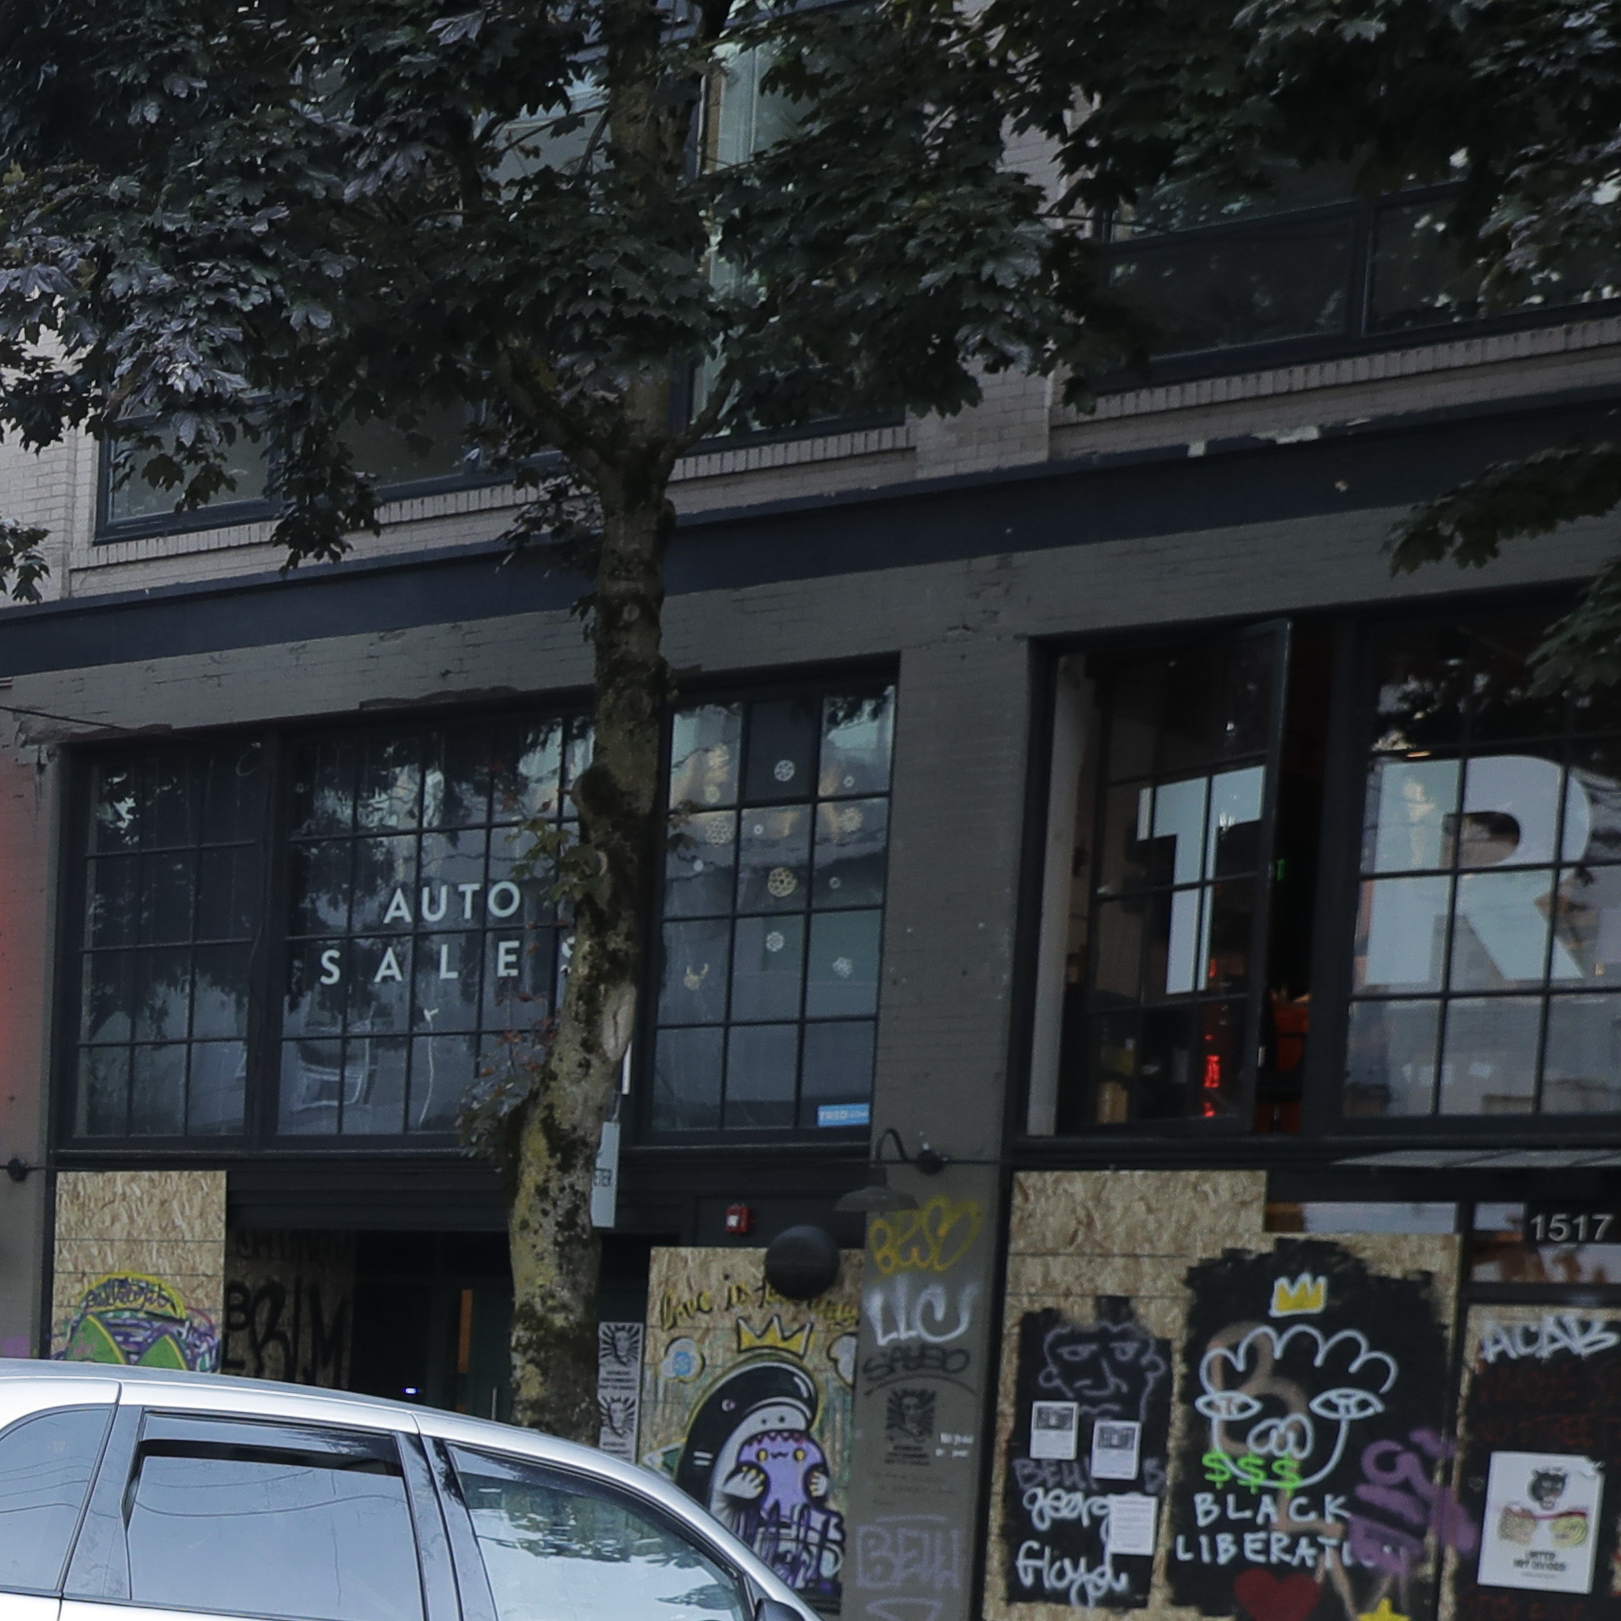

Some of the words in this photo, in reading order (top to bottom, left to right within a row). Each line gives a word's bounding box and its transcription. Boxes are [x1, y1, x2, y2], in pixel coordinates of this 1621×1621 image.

[383, 881, 521, 924] AUTO
[1530, 1213, 1613, 1242] 1517
[1193, 1492, 1353, 1528] BLACK
[1175, 1530, 1410, 1571] LIBERATI
